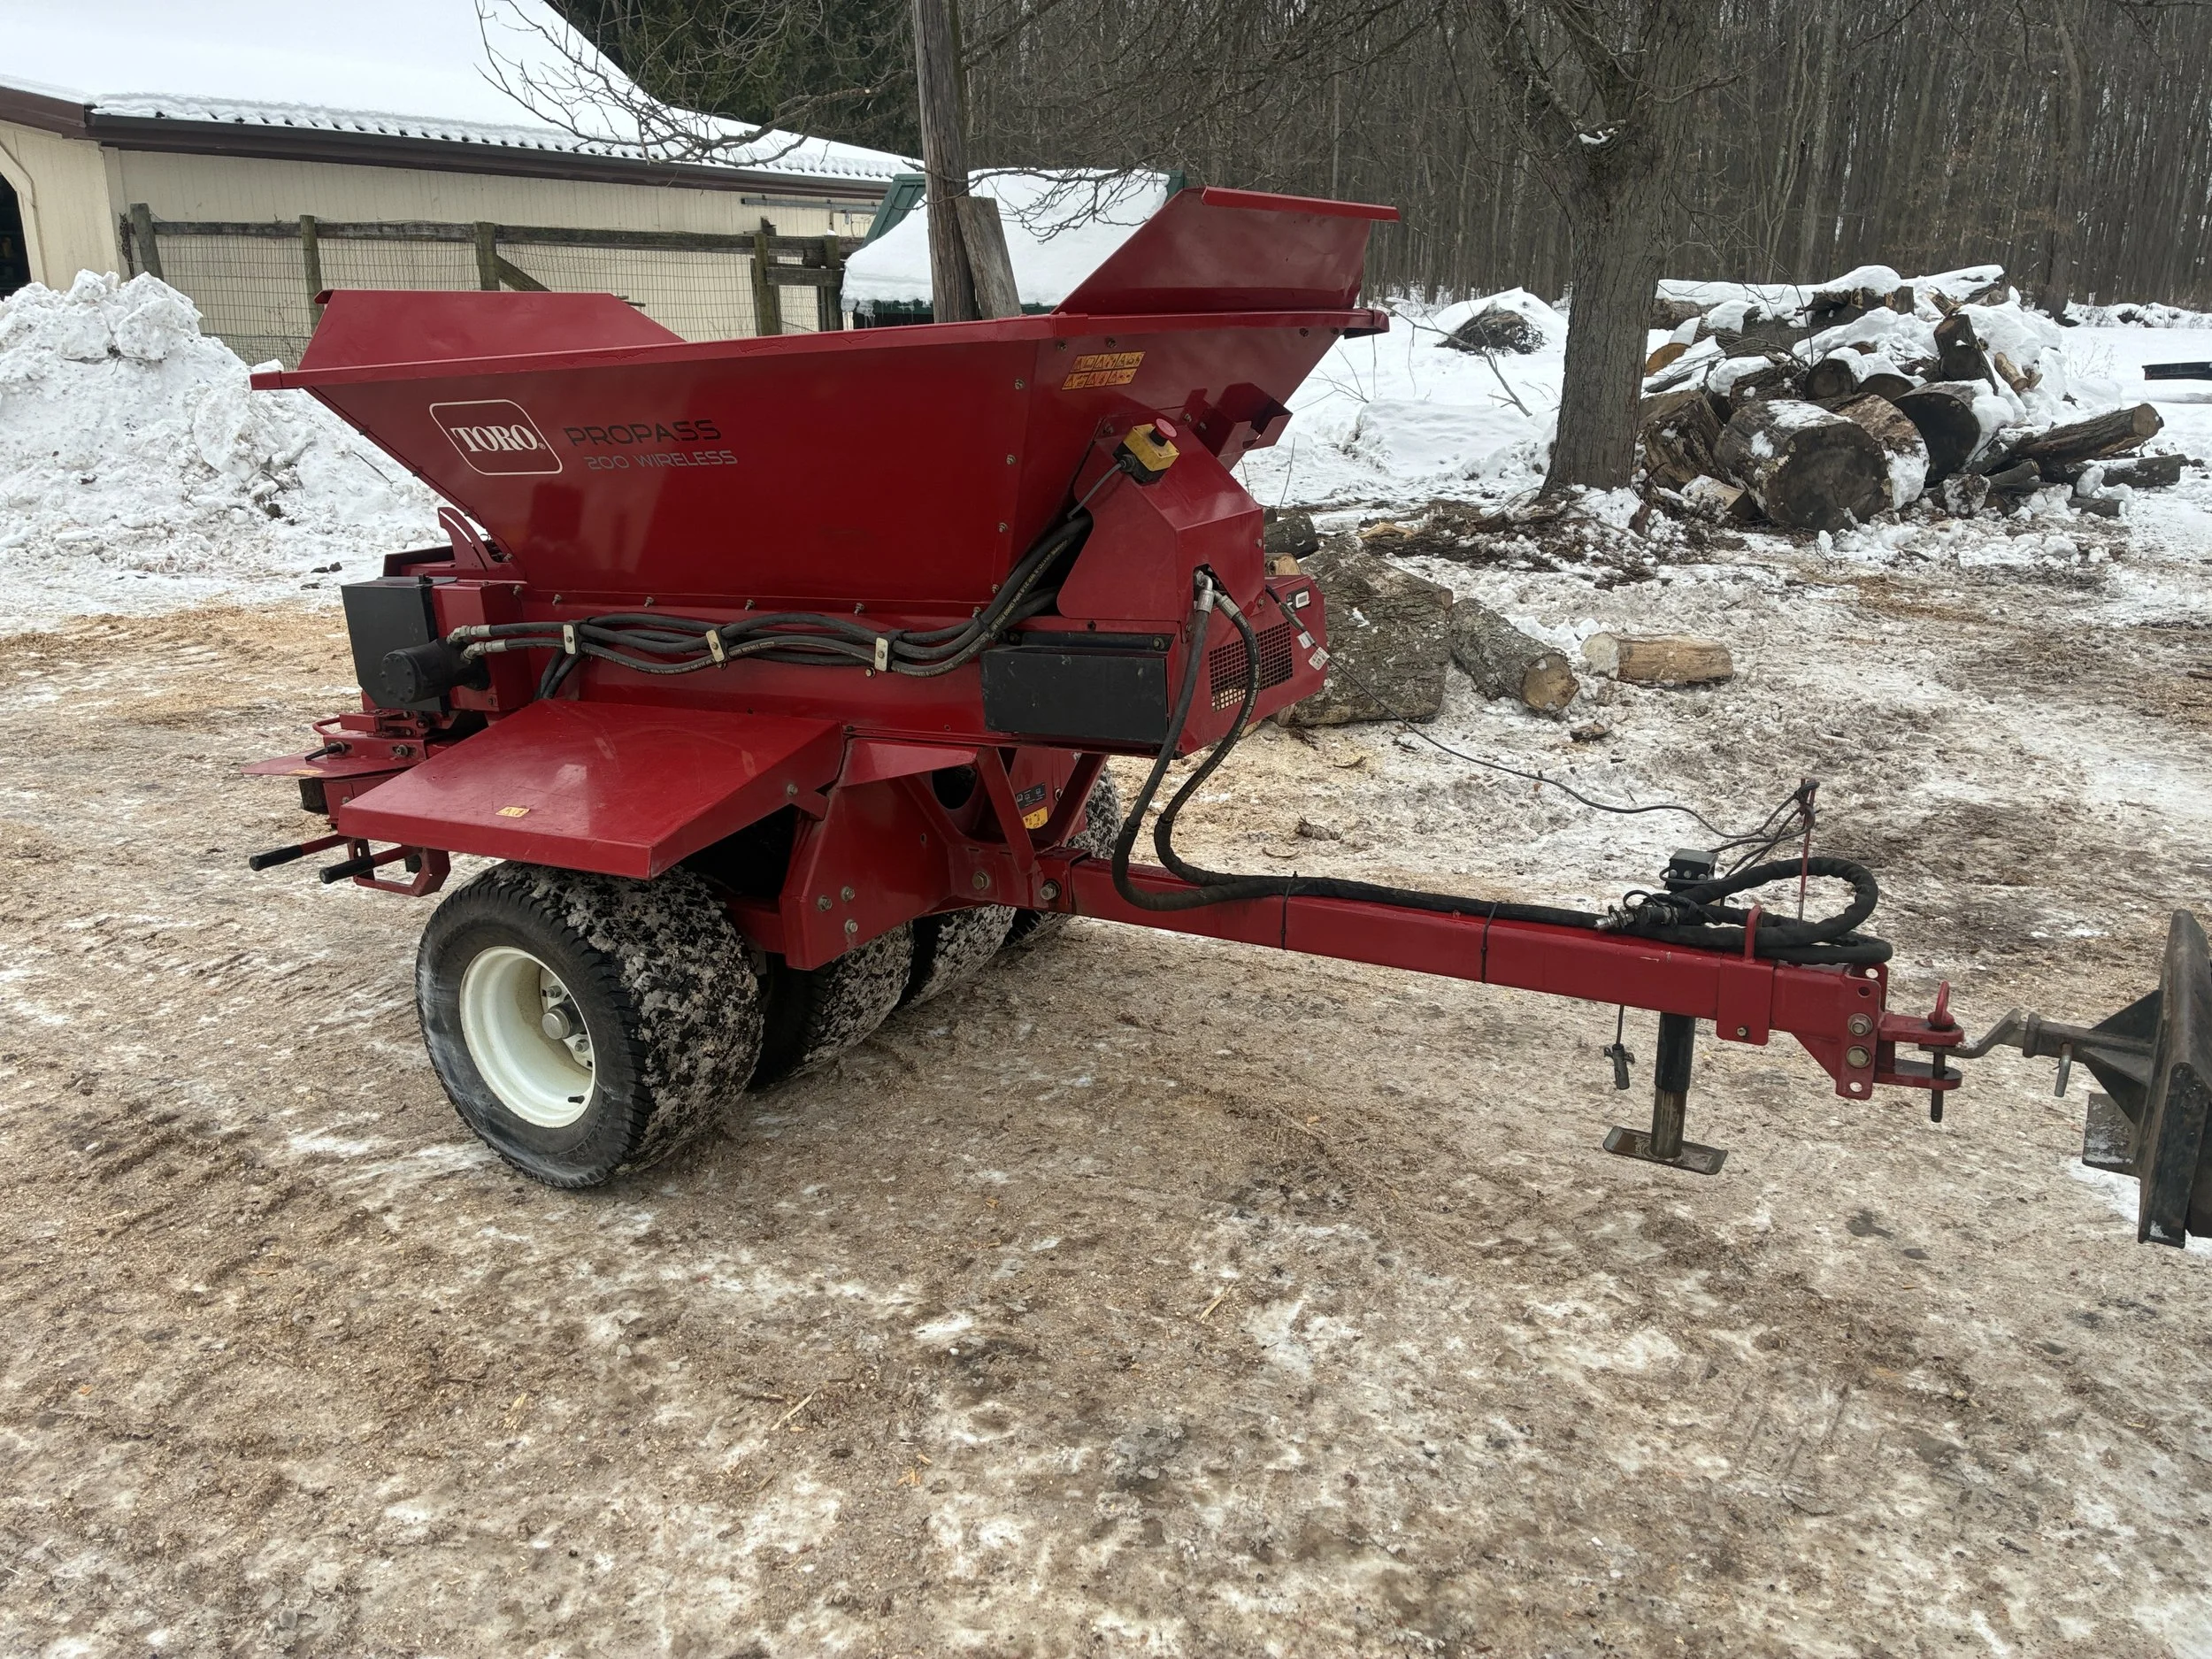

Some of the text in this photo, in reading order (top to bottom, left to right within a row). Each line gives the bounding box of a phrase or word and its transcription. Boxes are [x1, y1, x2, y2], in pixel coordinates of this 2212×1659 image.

[449, 425, 538, 452] TORO
[563, 419, 722, 447] PROPASS
[584, 449, 738, 470] 200 WIRELESS
